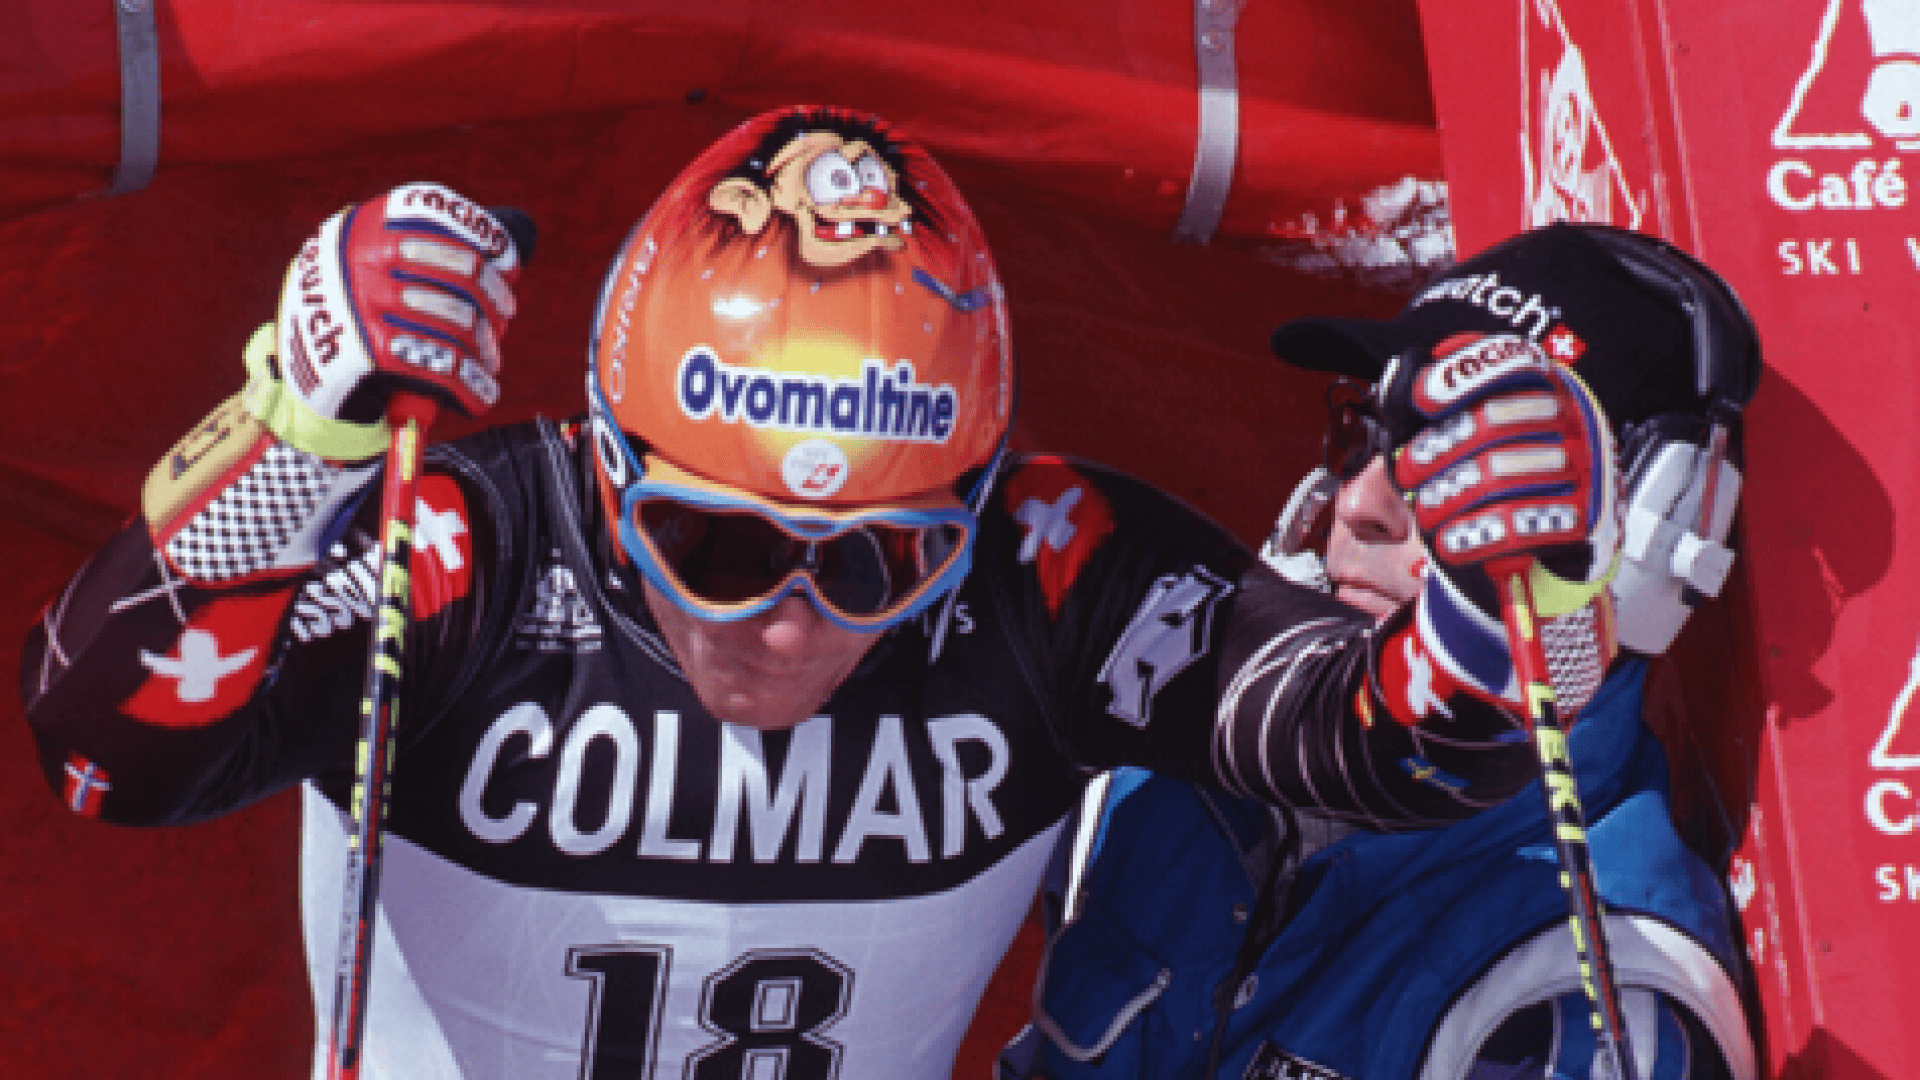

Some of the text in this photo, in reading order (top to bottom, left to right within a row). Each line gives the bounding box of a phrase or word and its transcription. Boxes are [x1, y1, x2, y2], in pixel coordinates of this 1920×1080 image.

[404, 187, 510, 257] racing
[1767, 157, 1908, 212] Café
[298, 233, 346, 367] eusch
[1776, 237, 1863, 276] SKI
[678, 349, 957, 442] Ovomaltine
[459, 702, 1011, 864] COLMAR
[1528, 681, 1585, 841] LEKI
[564, 943, 856, 1080] 18
